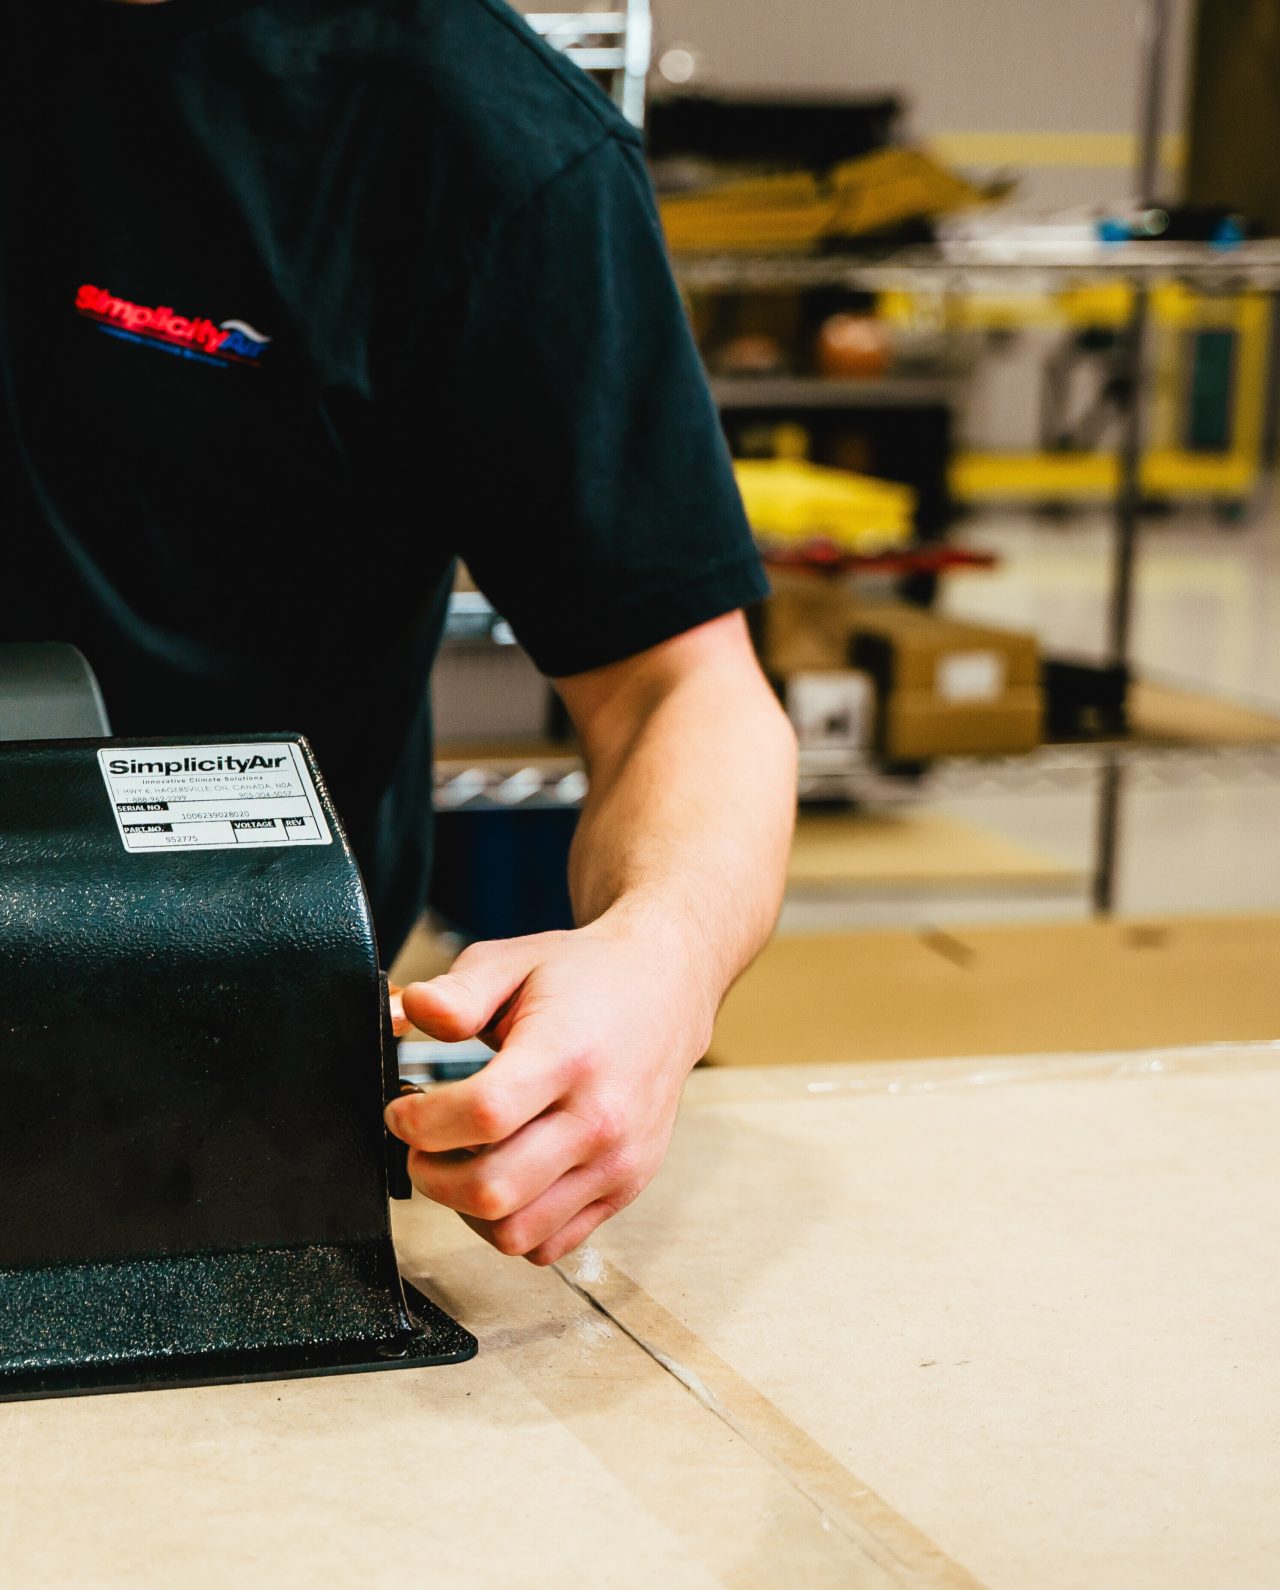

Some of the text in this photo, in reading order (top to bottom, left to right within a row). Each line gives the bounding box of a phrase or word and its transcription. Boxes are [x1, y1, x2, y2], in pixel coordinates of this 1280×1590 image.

[109, 755, 287, 776] SimplicityAir
[147, 804, 164, 812] NO.
[234, 820, 273, 829] VOLTAGE
[285, 819, 302, 827] REV
